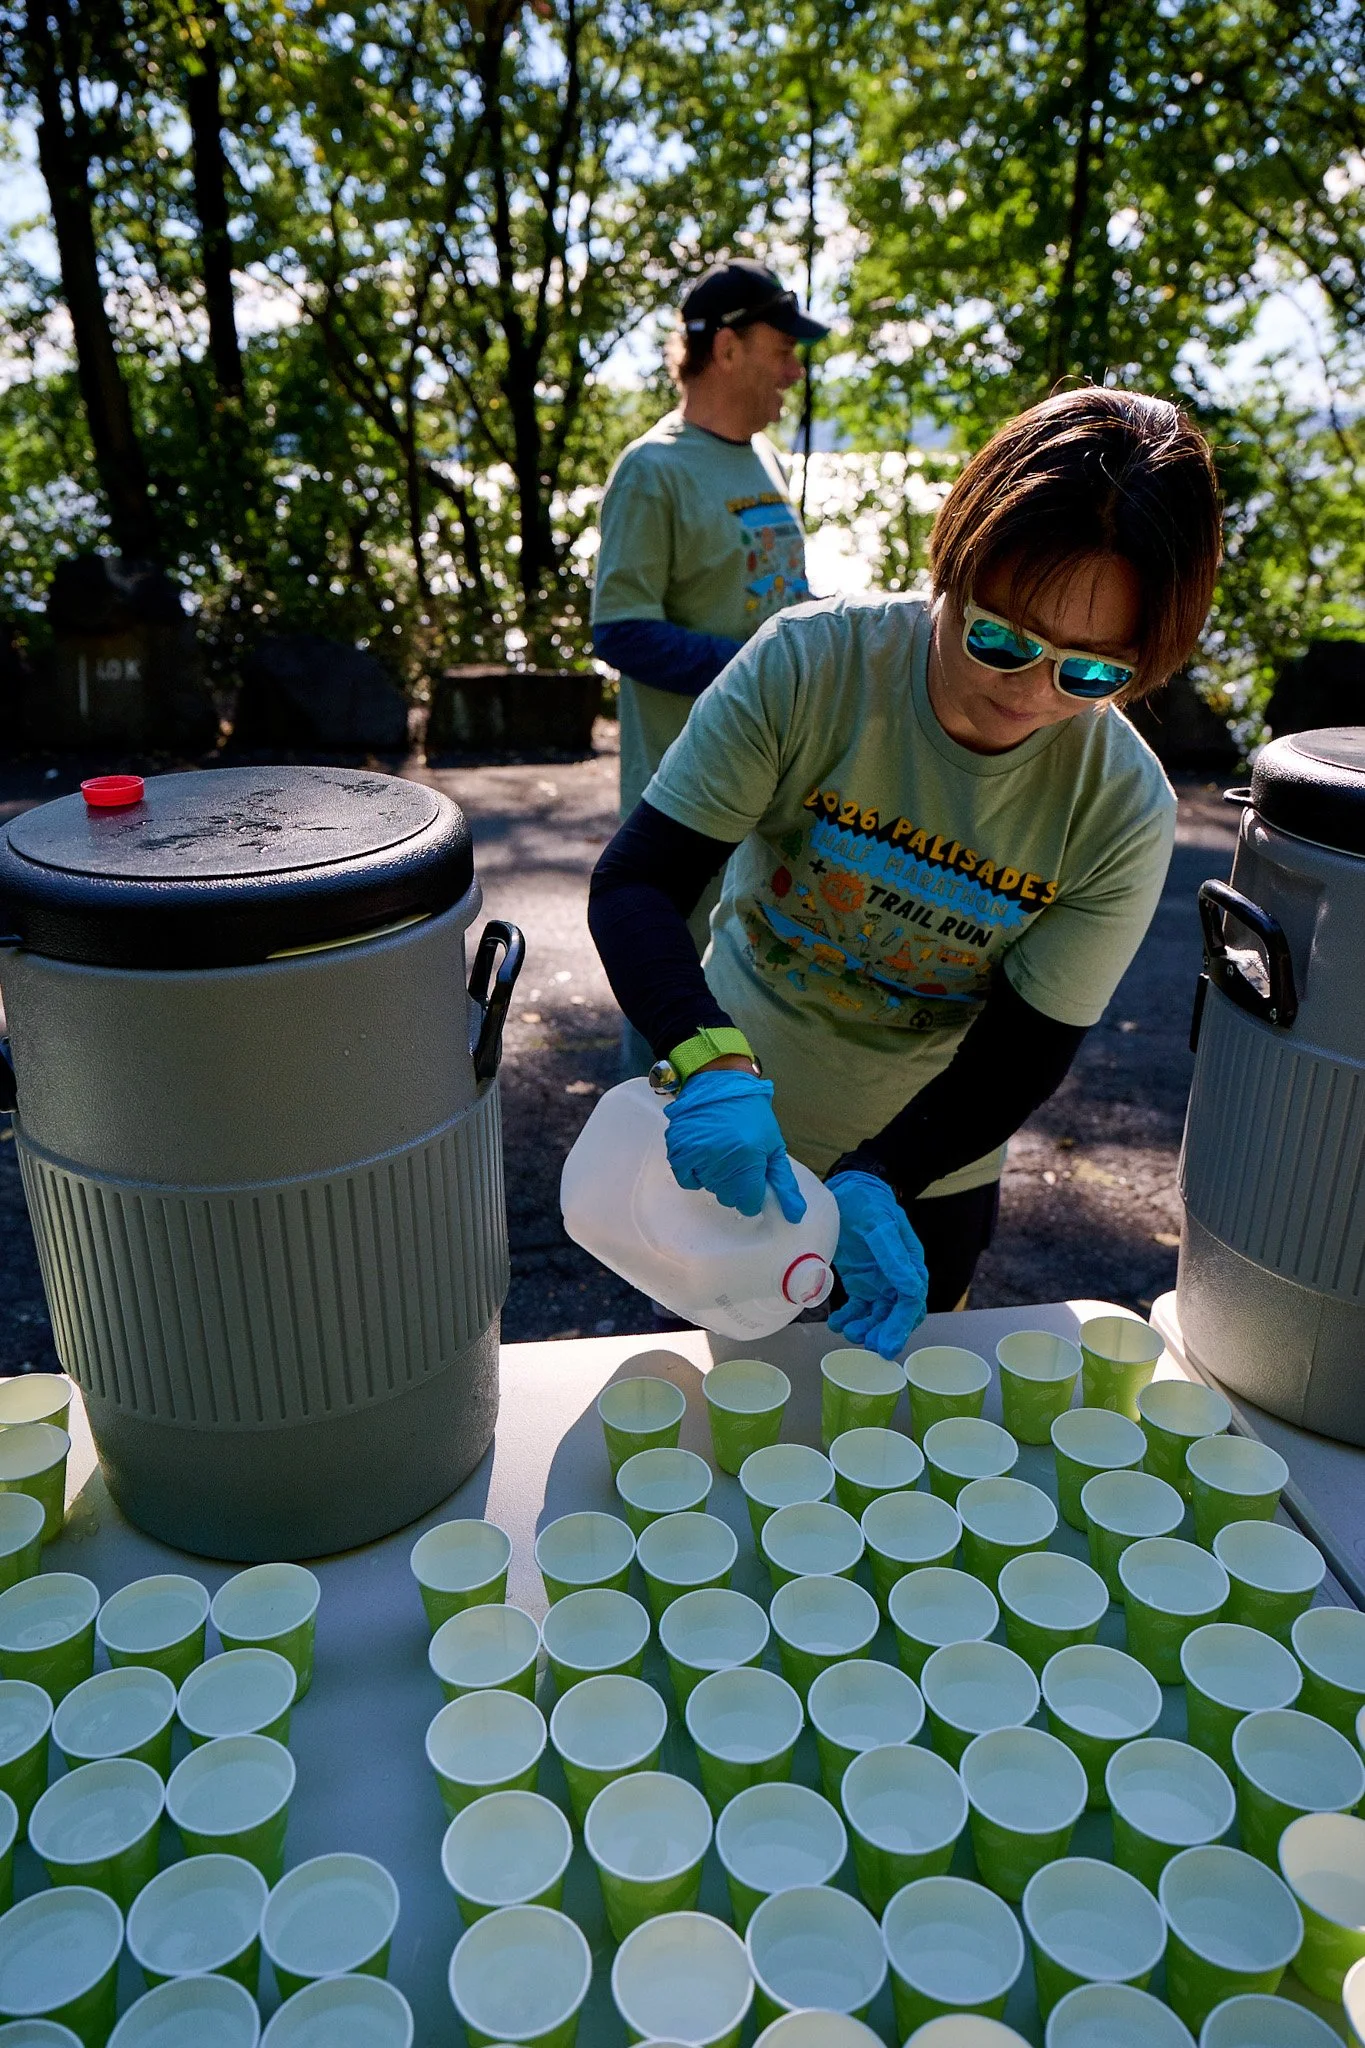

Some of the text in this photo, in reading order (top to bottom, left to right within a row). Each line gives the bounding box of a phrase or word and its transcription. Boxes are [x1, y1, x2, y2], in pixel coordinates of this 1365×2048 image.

[803, 787, 1057, 904] 2026 PALISADES
[818, 828, 1009, 918] HALF MARATHON
[866, 884, 934, 929] TRAIL
[937, 916, 993, 948] RUN
